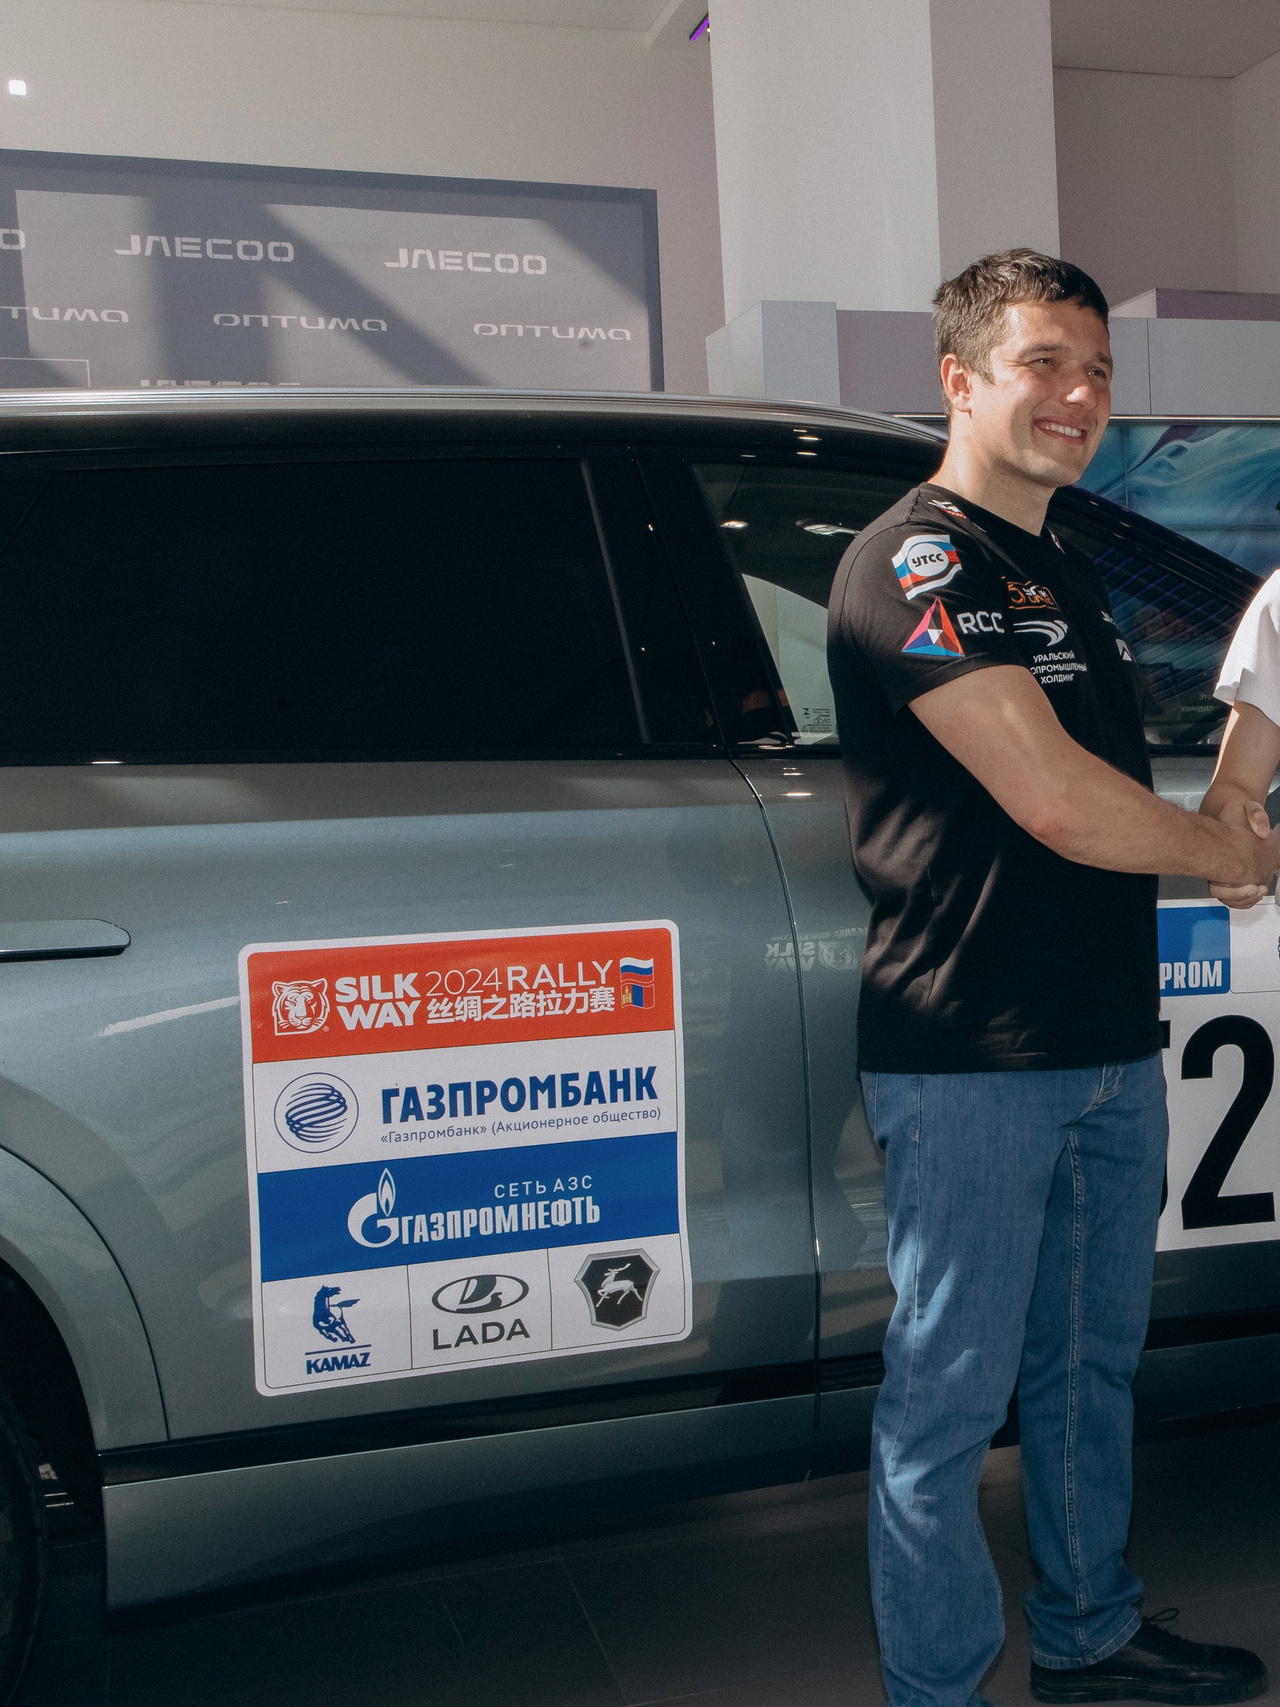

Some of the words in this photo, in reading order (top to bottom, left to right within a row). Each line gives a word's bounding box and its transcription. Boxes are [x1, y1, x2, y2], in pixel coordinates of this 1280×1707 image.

[114, 235, 295, 262] JAECOO
[384, 248, 547, 275] JAECOO
[956, 611, 1005, 634] RCC
[1033, 650, 1075, 663] УРАЛЬСКИЙ
[1040, 673, 1074, 684] ХОЛДИНГ
[335, 973, 421, 1003] SILK
[425, 967, 503, 997] 2024
[507, 959, 614, 991] RALLY
[337, 1000, 421, 1031] WAY
[426, 986, 616, 1025] 丝绸之路拉力赛
[381, 1065, 659, 1125] ГАЗПРОМБАНК
[380, 1123, 487, 1144] «Газпромбанк»
[491, 1114, 589, 1136] (Акционерное
[592, 1106, 662, 1126] общество)
[494, 1180, 547, 1199] СЕТЬ
[552, 1175, 593, 1193] АЗС
[401, 1195, 601, 1245] ГАЗПРОМНЕФТЬ
[433, 1318, 531, 1350] LADA
[306, 1352, 371, 1375] KAMAZ
